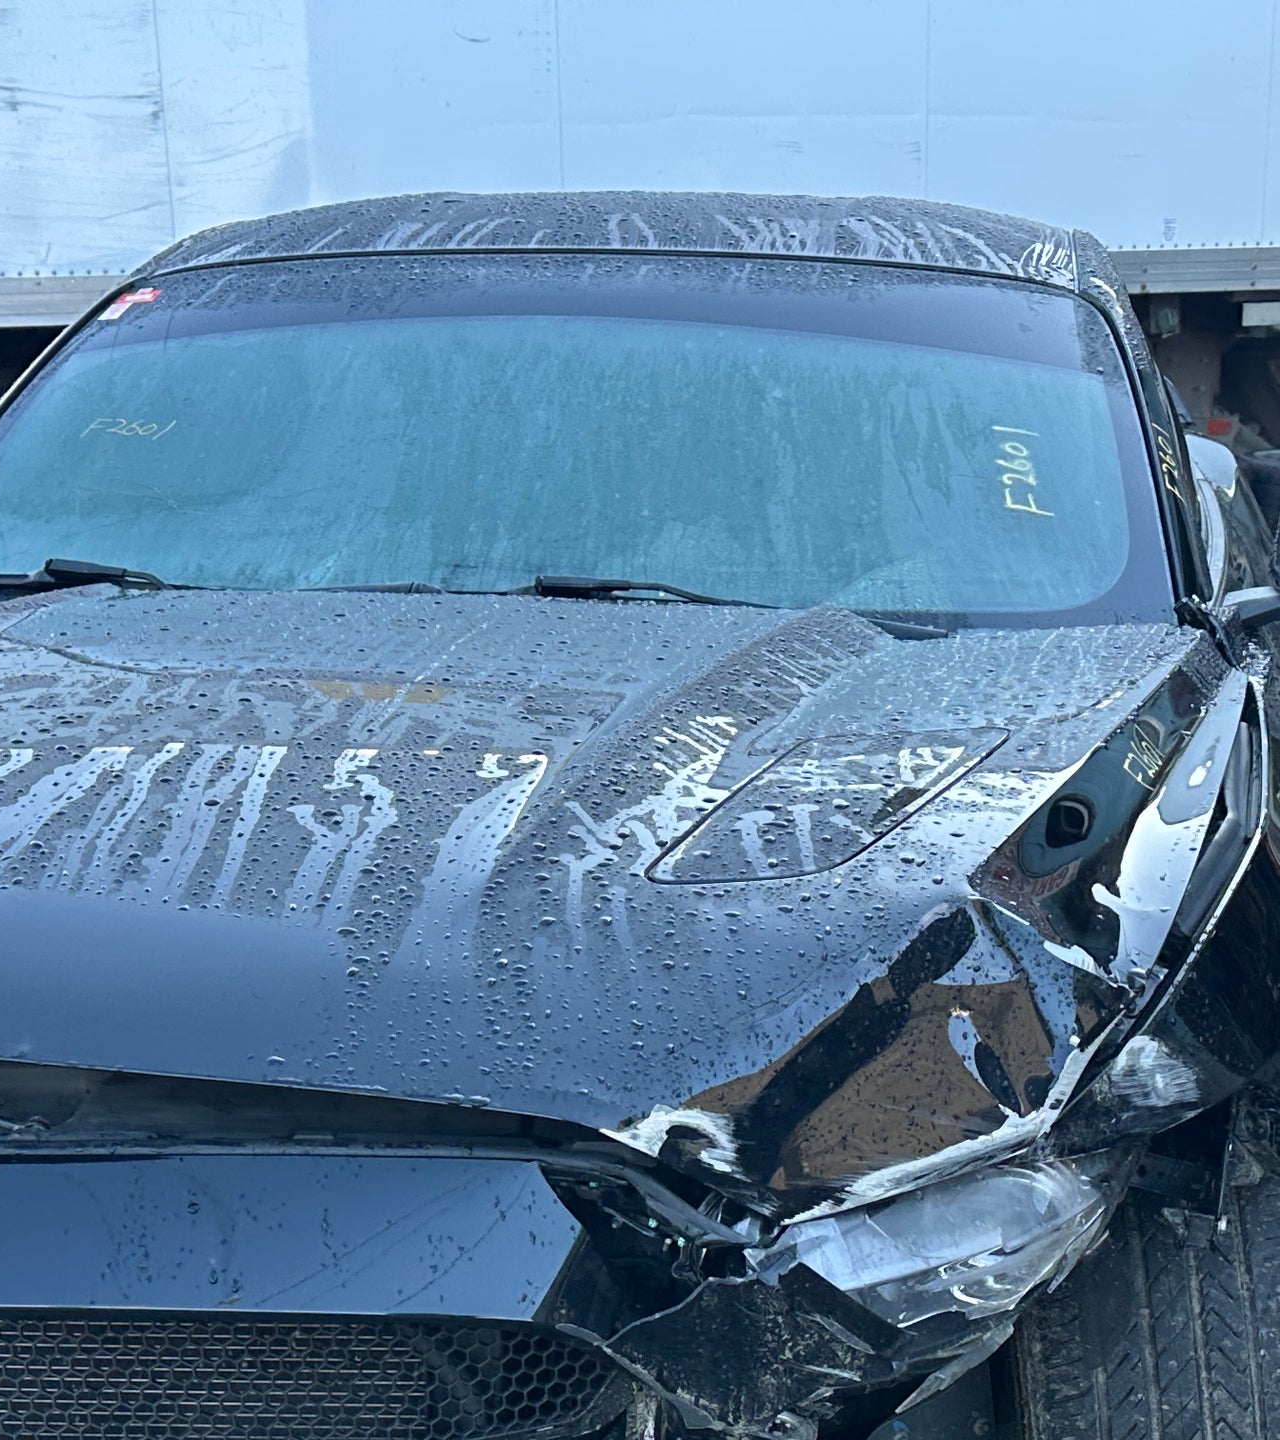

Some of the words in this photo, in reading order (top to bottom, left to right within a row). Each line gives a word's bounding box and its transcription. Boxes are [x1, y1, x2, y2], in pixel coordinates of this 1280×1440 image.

[80, 418, 177, 440] F2601
[991, 425, 1055, 516] F2601
[1151, 422, 1187, 505] F2601
